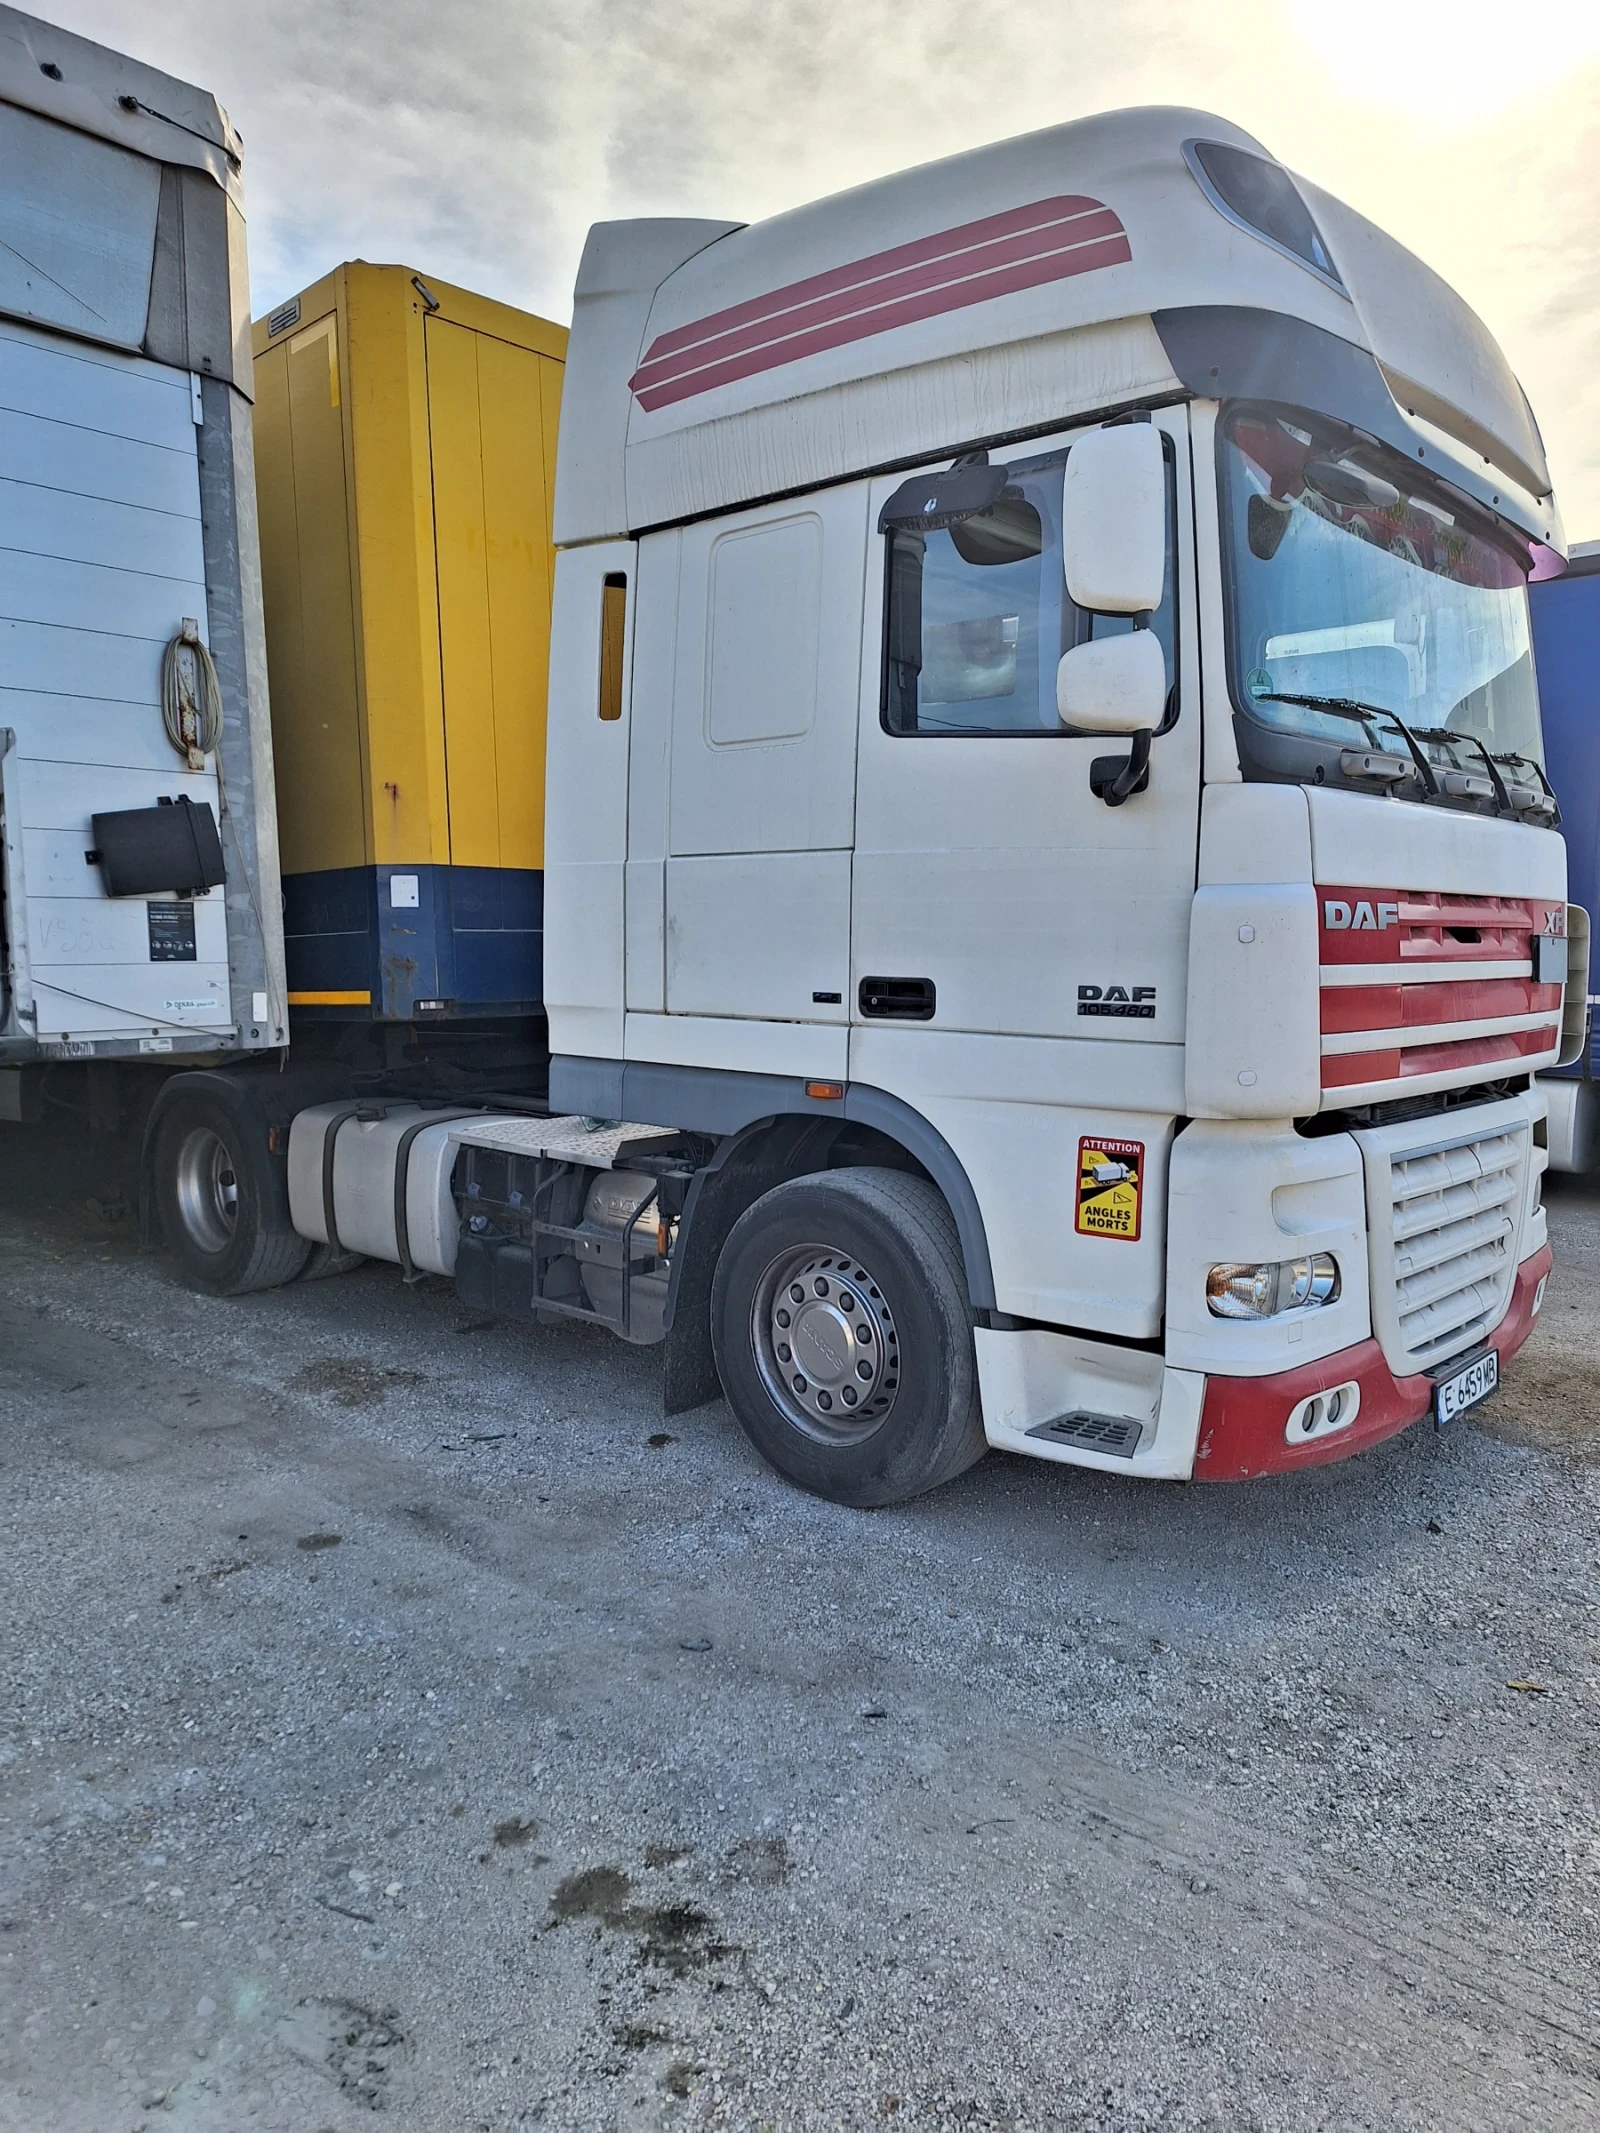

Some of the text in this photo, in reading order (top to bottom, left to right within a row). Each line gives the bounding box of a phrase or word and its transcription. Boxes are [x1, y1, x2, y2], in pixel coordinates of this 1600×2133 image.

[1324, 900, 1398, 930] DAF
[1543, 911, 1564, 934] XF
[1078, 985, 1156, 1002] DAF
[1077, 1003, 1155, 1018] 105.460
[1082, 1139, 1140, 1154] ATTENTION
[1084, 1205, 1131, 1221] ANGLES
[1086, 1216, 1129, 1231] MORTS
[1445, 1384, 1454, 1415] E
